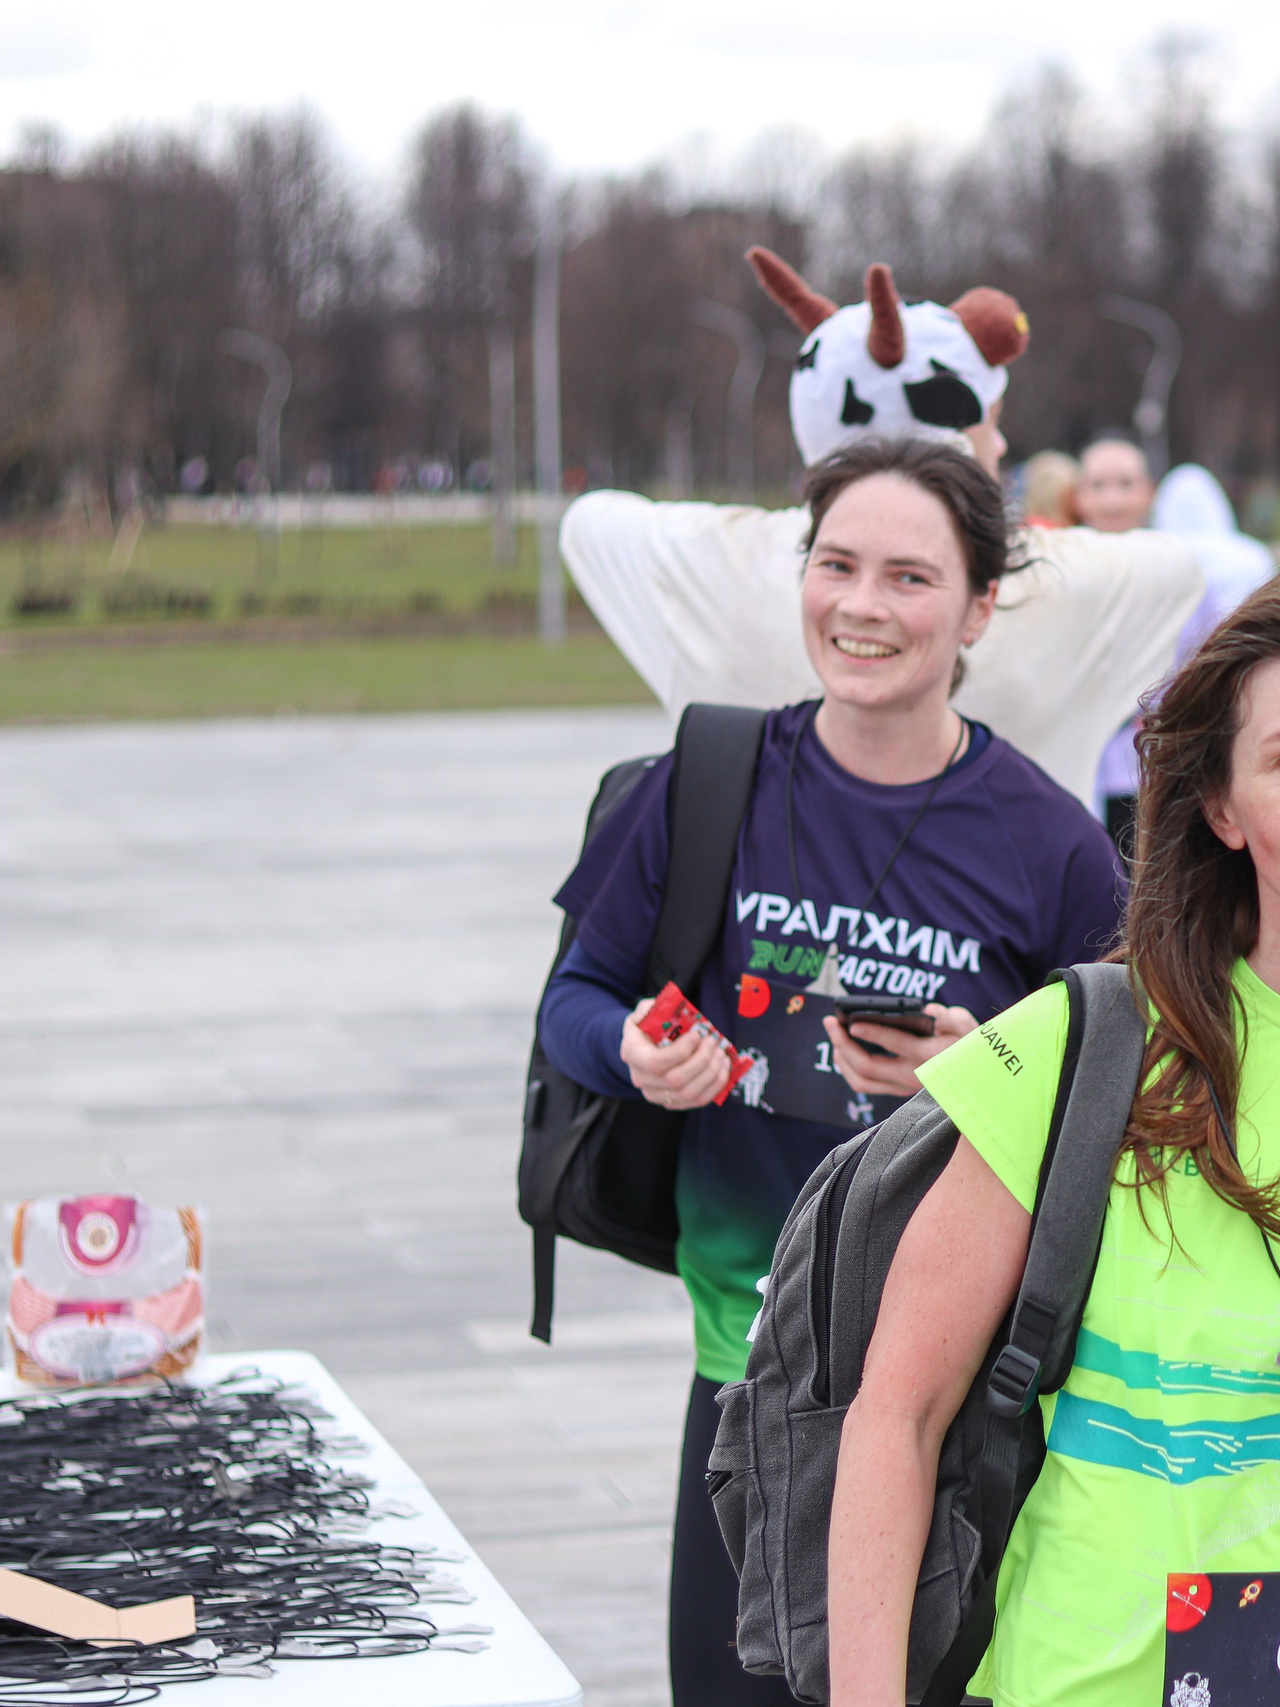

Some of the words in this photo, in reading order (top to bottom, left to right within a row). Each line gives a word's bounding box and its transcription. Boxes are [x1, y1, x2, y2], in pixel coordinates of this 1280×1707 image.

[736, 888, 982, 973] УРАЛХИМ
[838, 953, 948, 1000] ACTORY
[980, 1022, 1023, 1076] UAWEI
